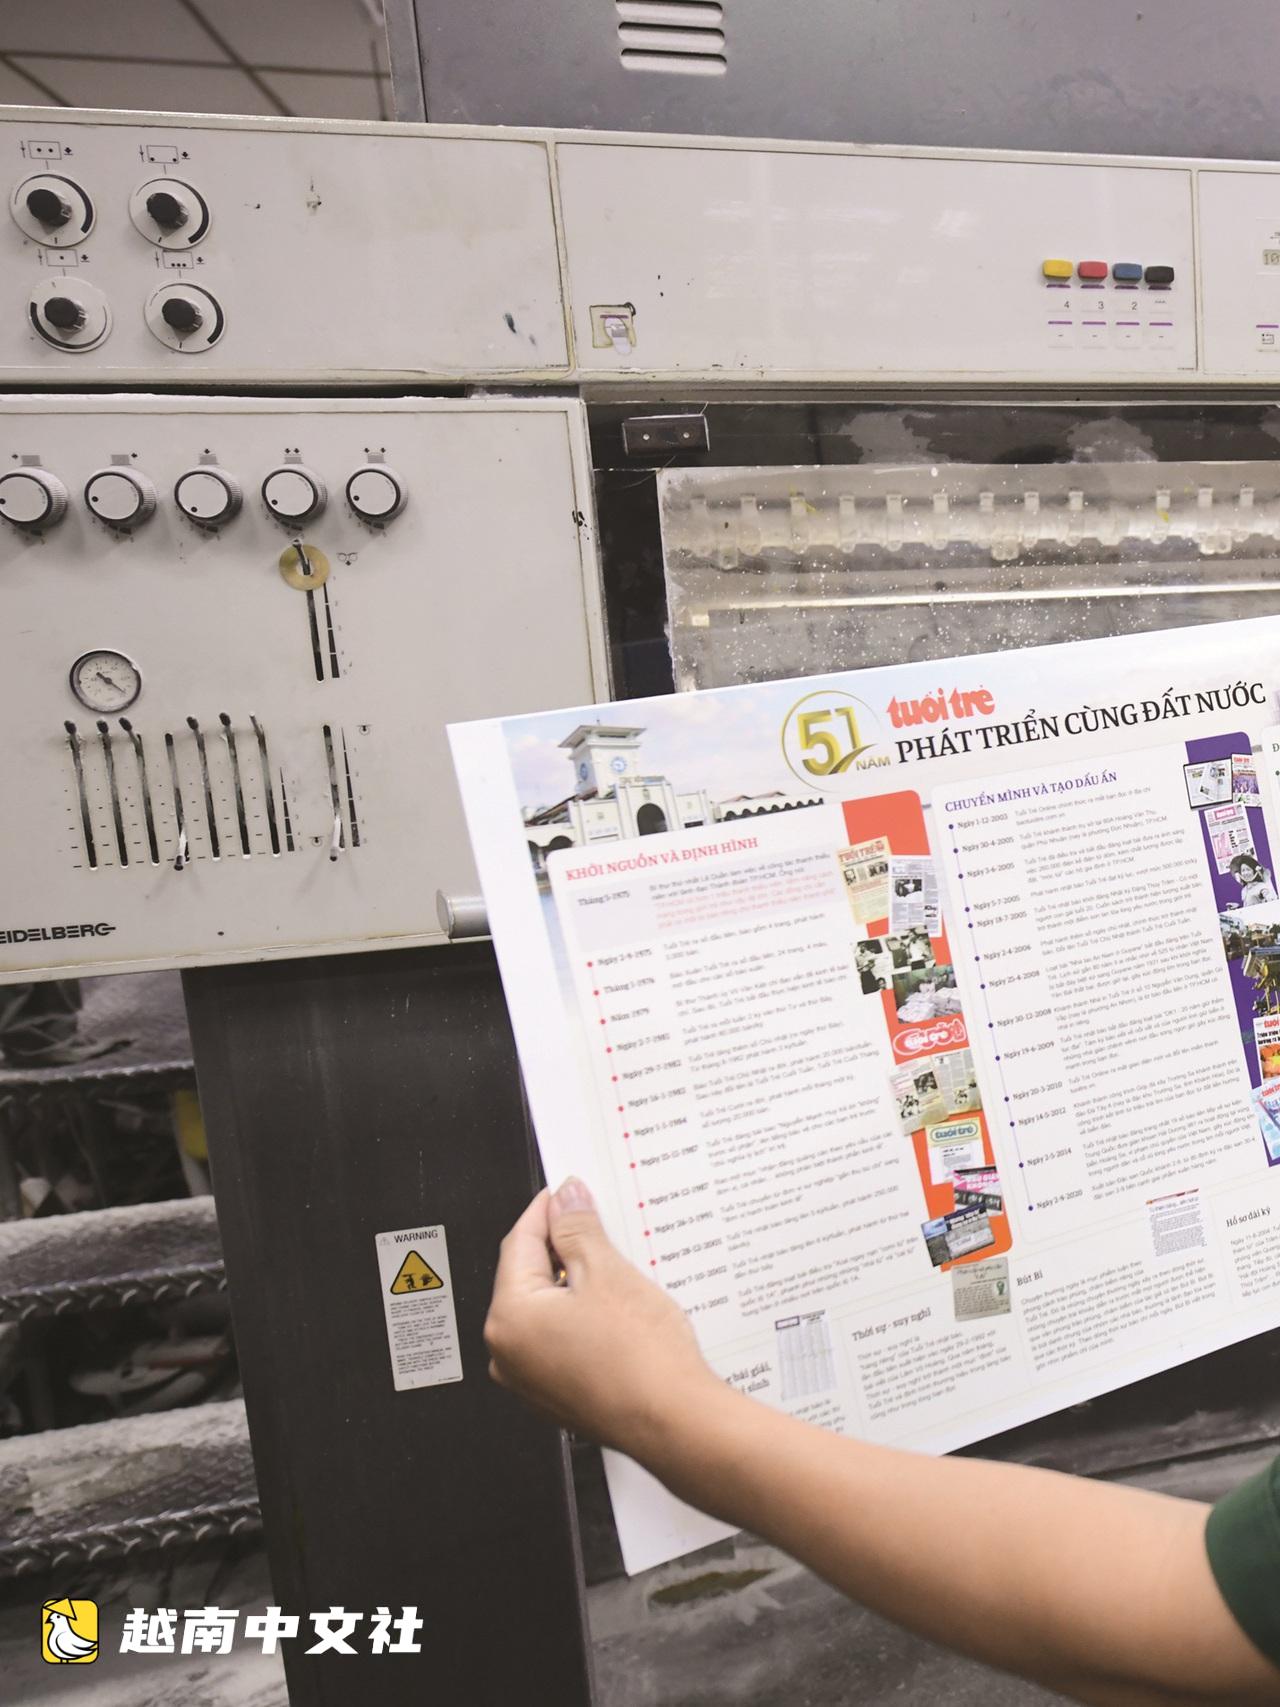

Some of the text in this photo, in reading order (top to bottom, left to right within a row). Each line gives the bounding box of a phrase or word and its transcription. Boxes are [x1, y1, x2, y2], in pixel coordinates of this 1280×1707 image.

[1064, 301, 1138, 310] 4 3 2
[886, 684, 996, 729] tuổi trẻ
[895, 680, 1267, 764] PHÁT TRIỂN CÙNG ĐẤT NƯỚC
[800, 698, 864, 777] 51
[856, 754, 891, 772] NĂM
[944, 791, 995, 812] CHUYỂN
[996, 787, 1031, 802] MÌNH
[1031, 782, 1049, 796] VÀ
[1049, 779, 1074, 794] TẠO
[1074, 772, 1099, 788] DẤU
[1100, 768, 1117, 784] ẤN
[956, 820, 975, 829] Ngày
[961, 843, 979, 852] Ngày
[565, 836, 758, 881] KHỞI NGUỒN VÀ ĐỊNH HÌNH
[966, 869, 984, 878] Ngày
[972, 901, 991, 910] Ngày
[976, 918, 994, 928] Ngày
[982, 951, 1001, 960] Ngày
[988, 978, 1006, 988] Ngày
[996, 1018, 1014, 1027] Ngày
[1003, 1050, 1021, 1059] Ngày
[1011, 1091, 1030, 1100] Ngày
[1017, 1116, 1035, 1126] Ngày
[1026, 1156, 1044, 1166] Ngày
[1035, 1199, 1053, 1209] Ngày
[394, 1229, 439, 1244] WARNING
